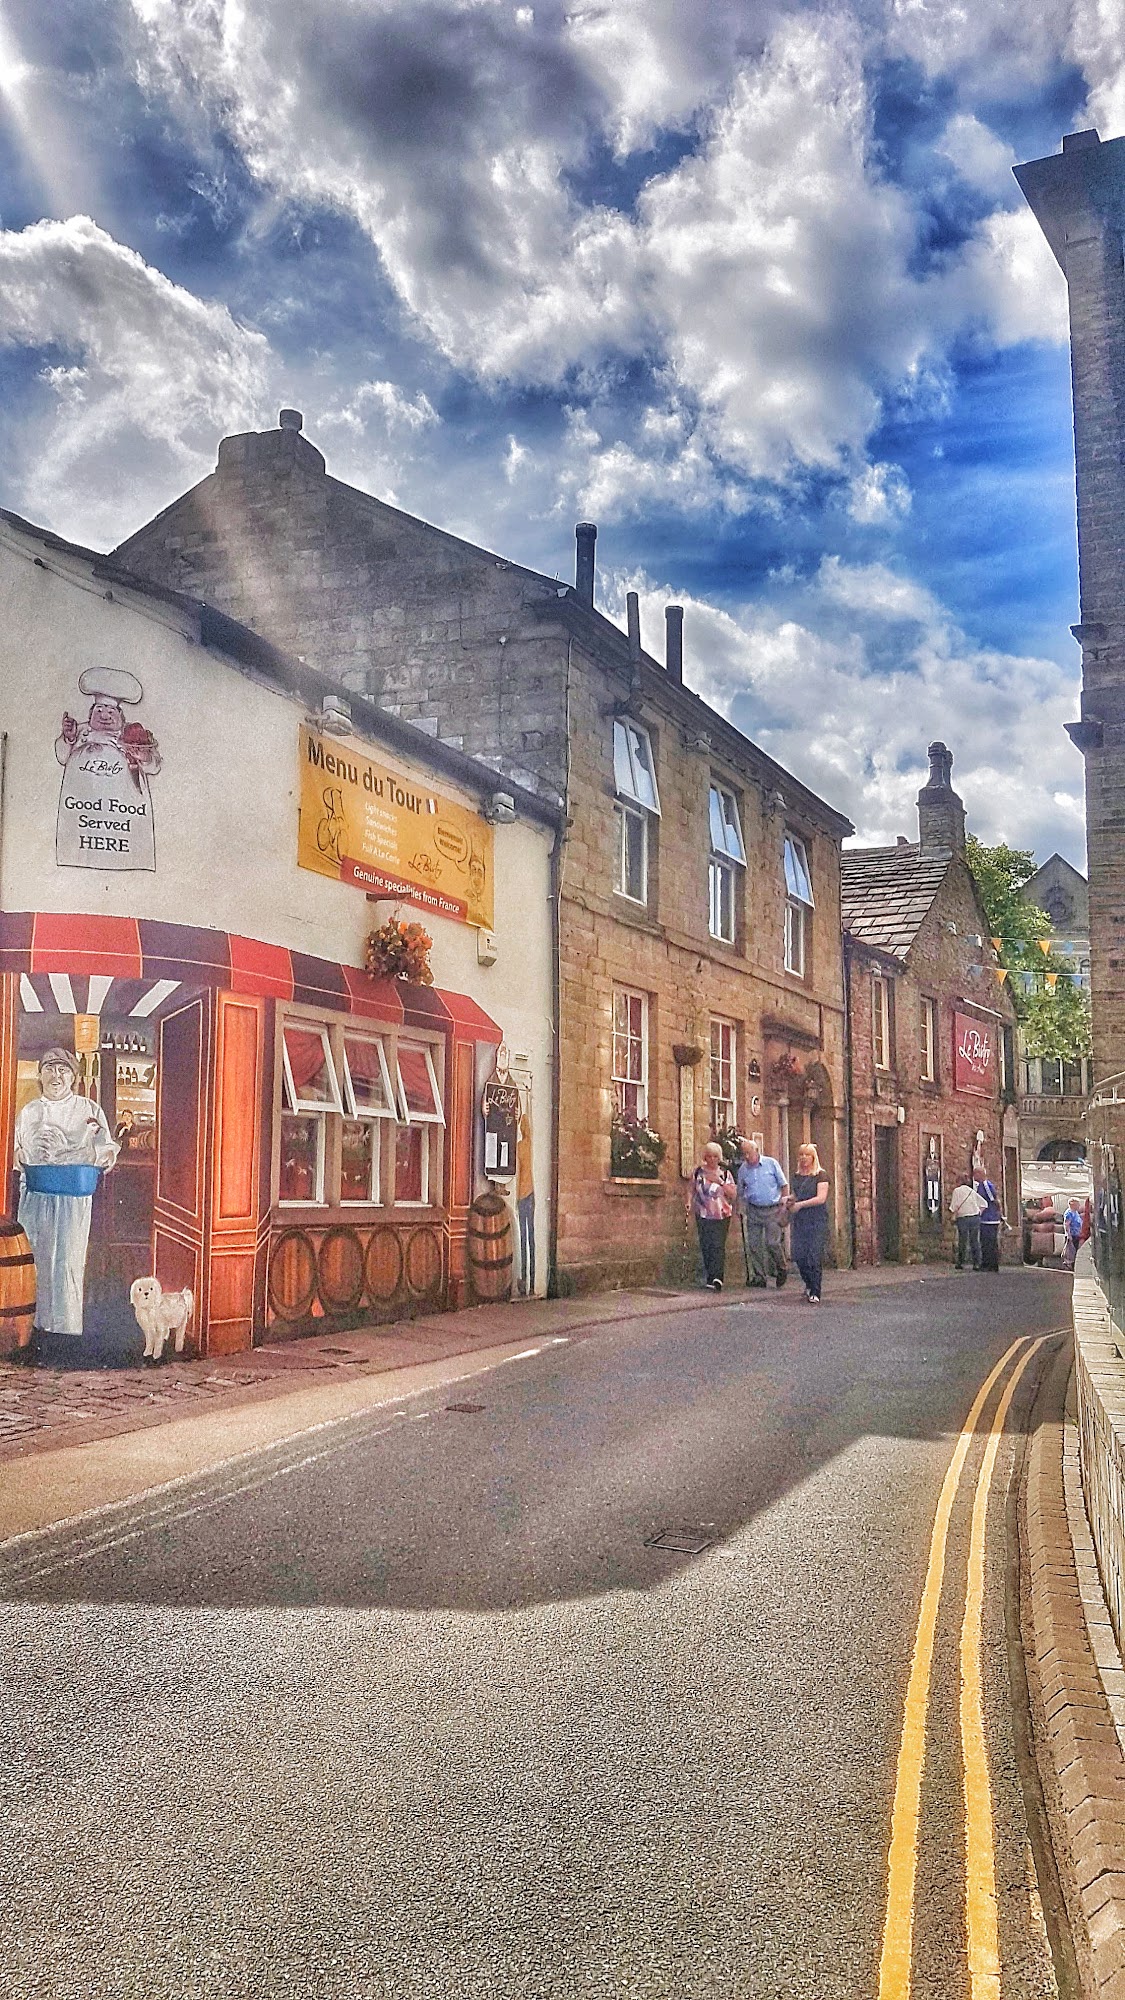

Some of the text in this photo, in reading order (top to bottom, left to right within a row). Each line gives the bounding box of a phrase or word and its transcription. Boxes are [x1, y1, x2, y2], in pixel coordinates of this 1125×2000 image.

[308, 736, 422, 815] Menu du Tour
[64, 796, 147, 816] Good Food
[78, 814, 131, 832] Served
[79, 835, 130, 852] HERE
[353, 866, 460, 914] Genuine specialities from France
[959, 1030, 973, 1064] Le
